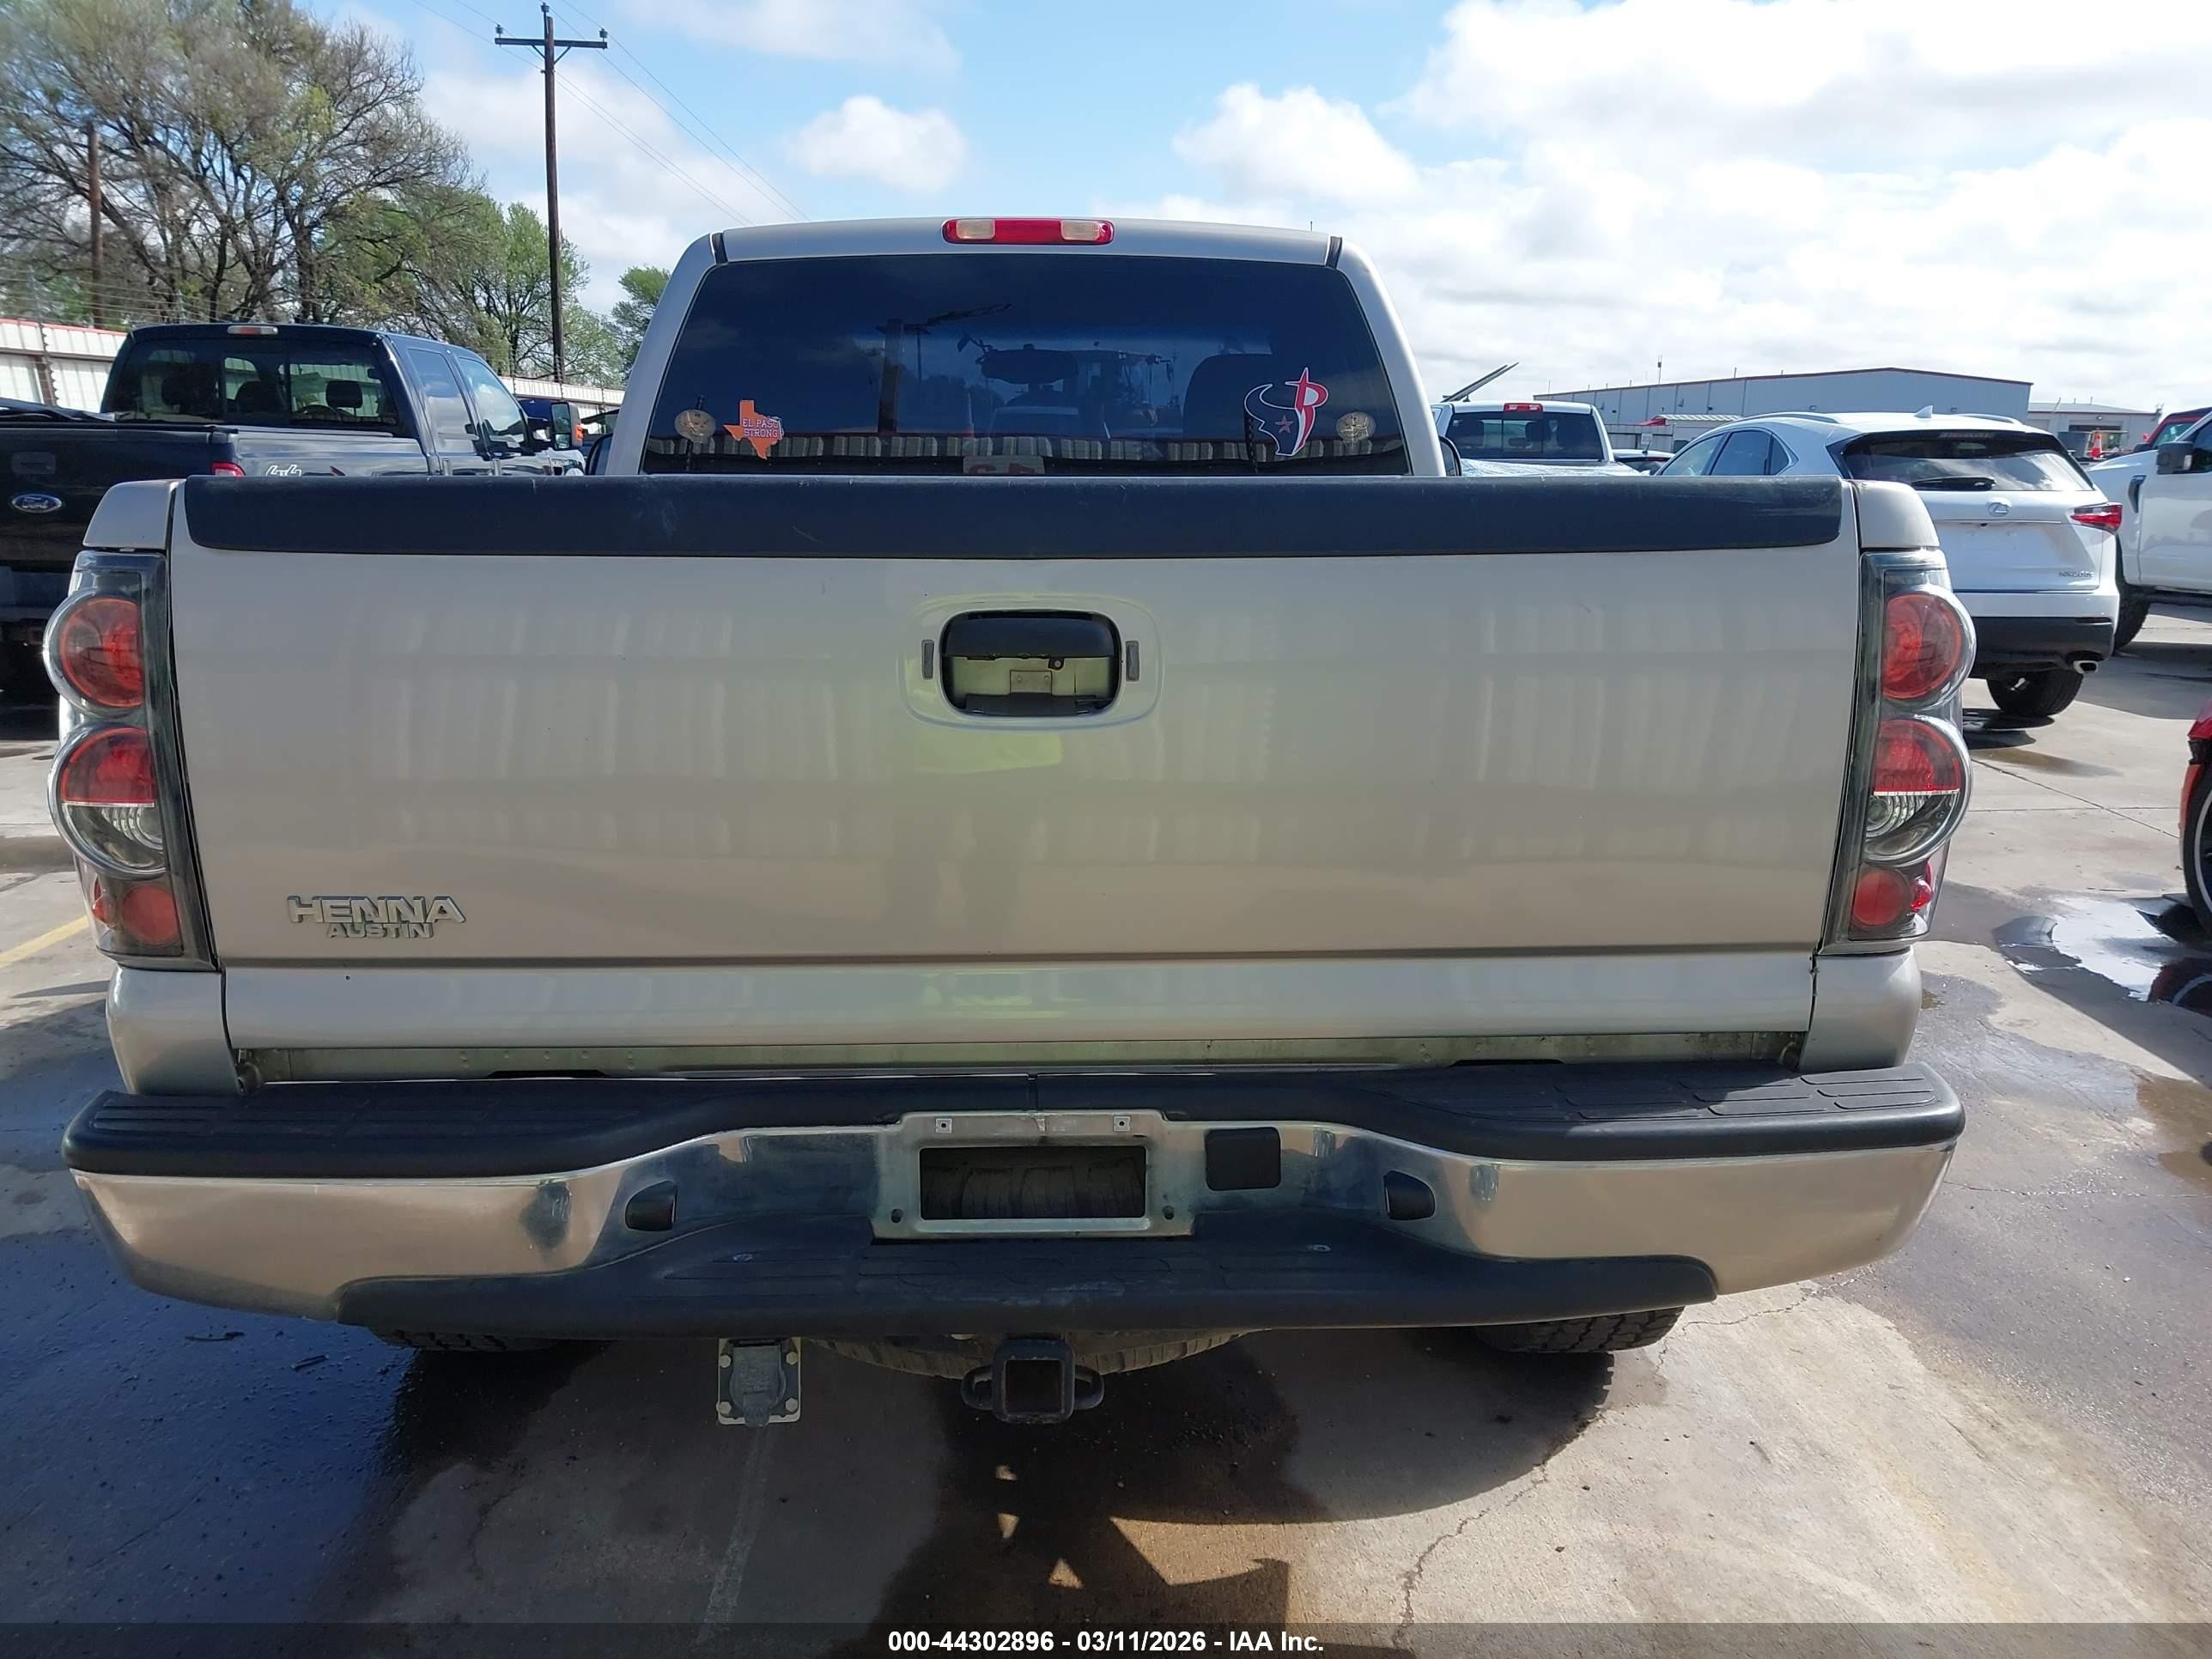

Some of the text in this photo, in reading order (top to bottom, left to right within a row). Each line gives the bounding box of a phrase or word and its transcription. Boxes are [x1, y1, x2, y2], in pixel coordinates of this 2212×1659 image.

[742, 418, 754, 428] EL
[744, 428, 779, 438] STRONG
[287, 895, 467, 924] HENNA
[327, 922, 434, 939] AUSTIN
